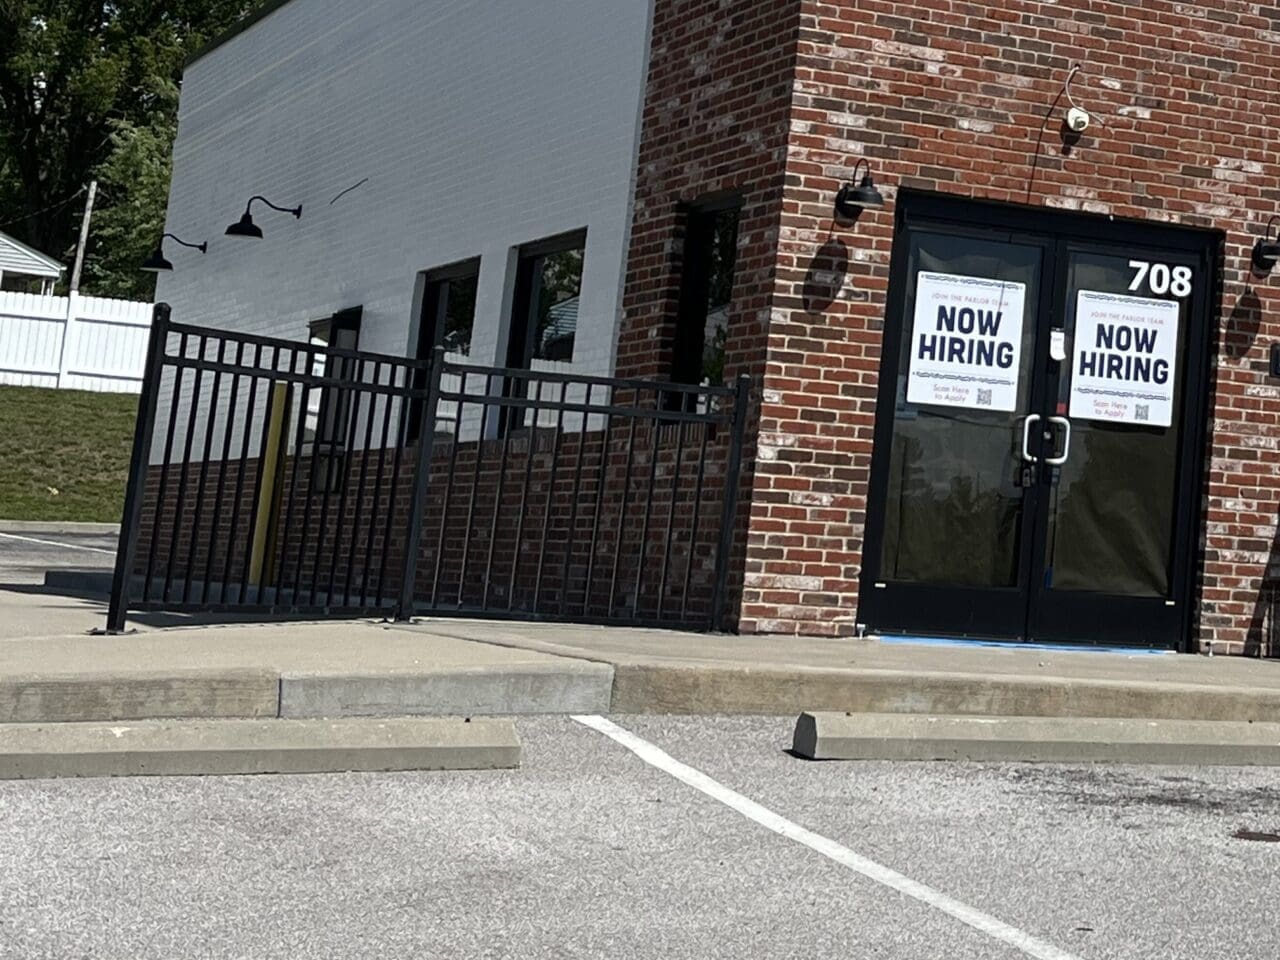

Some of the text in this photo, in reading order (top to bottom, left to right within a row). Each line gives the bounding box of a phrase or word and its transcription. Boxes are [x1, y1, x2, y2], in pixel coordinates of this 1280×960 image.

[1128, 260, 1192, 297] 708
[936, 305, 1003, 336] NOW
[918, 334, 1014, 369] HIRING
[1096, 323, 1157, 354] NOW
[1079, 351, 1169, 385] HIRING
